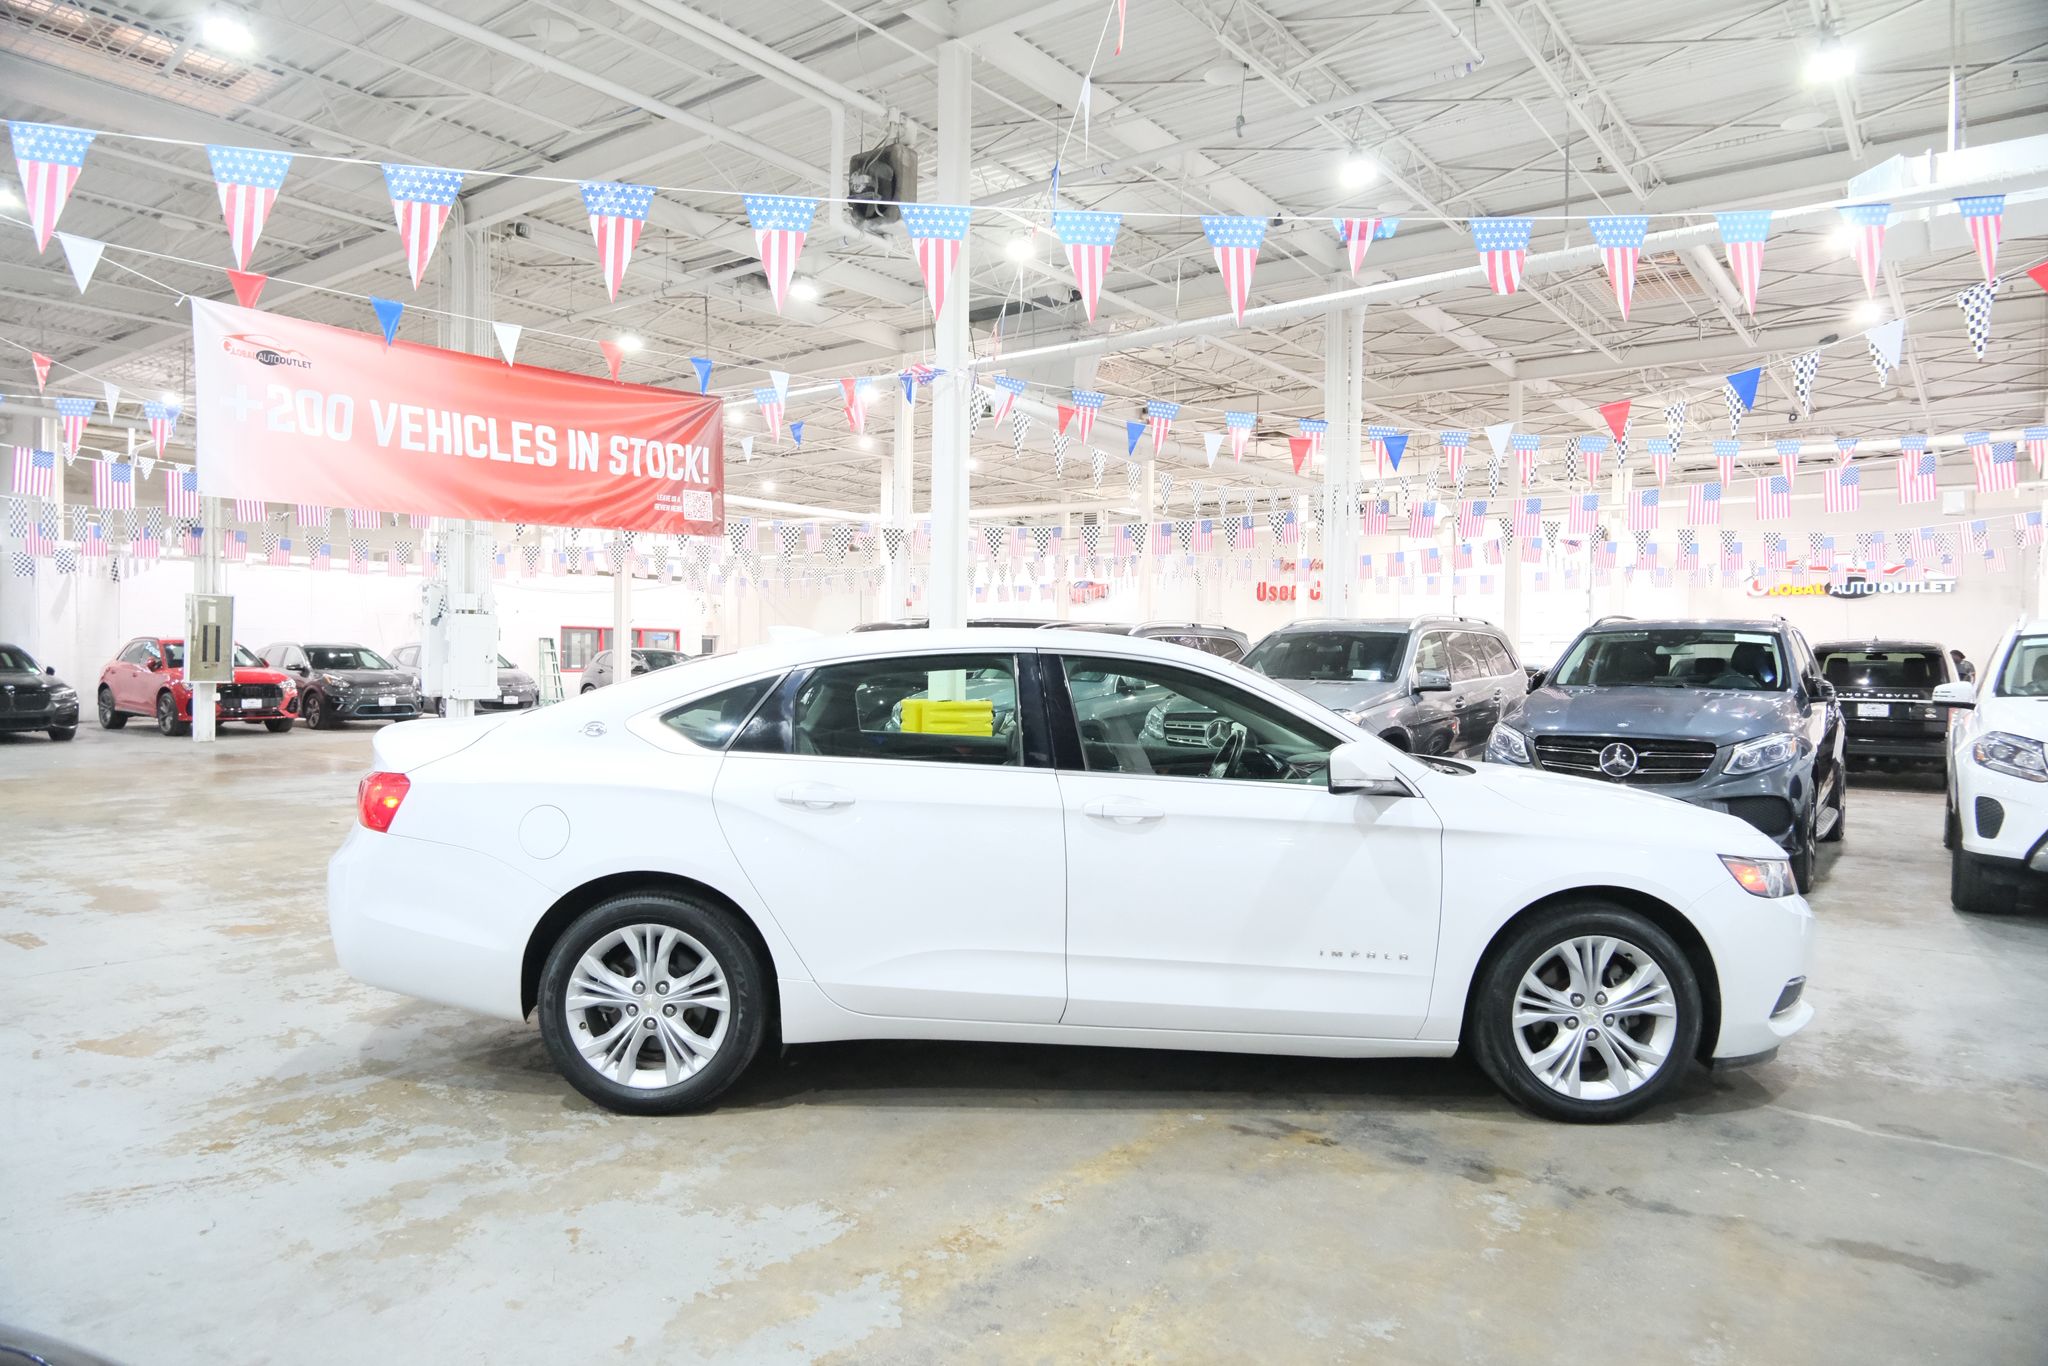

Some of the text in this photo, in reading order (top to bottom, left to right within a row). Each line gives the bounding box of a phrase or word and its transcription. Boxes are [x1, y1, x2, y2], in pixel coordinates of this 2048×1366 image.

[218, 383, 709, 484] +200 VEHICLES IN STOCK!
